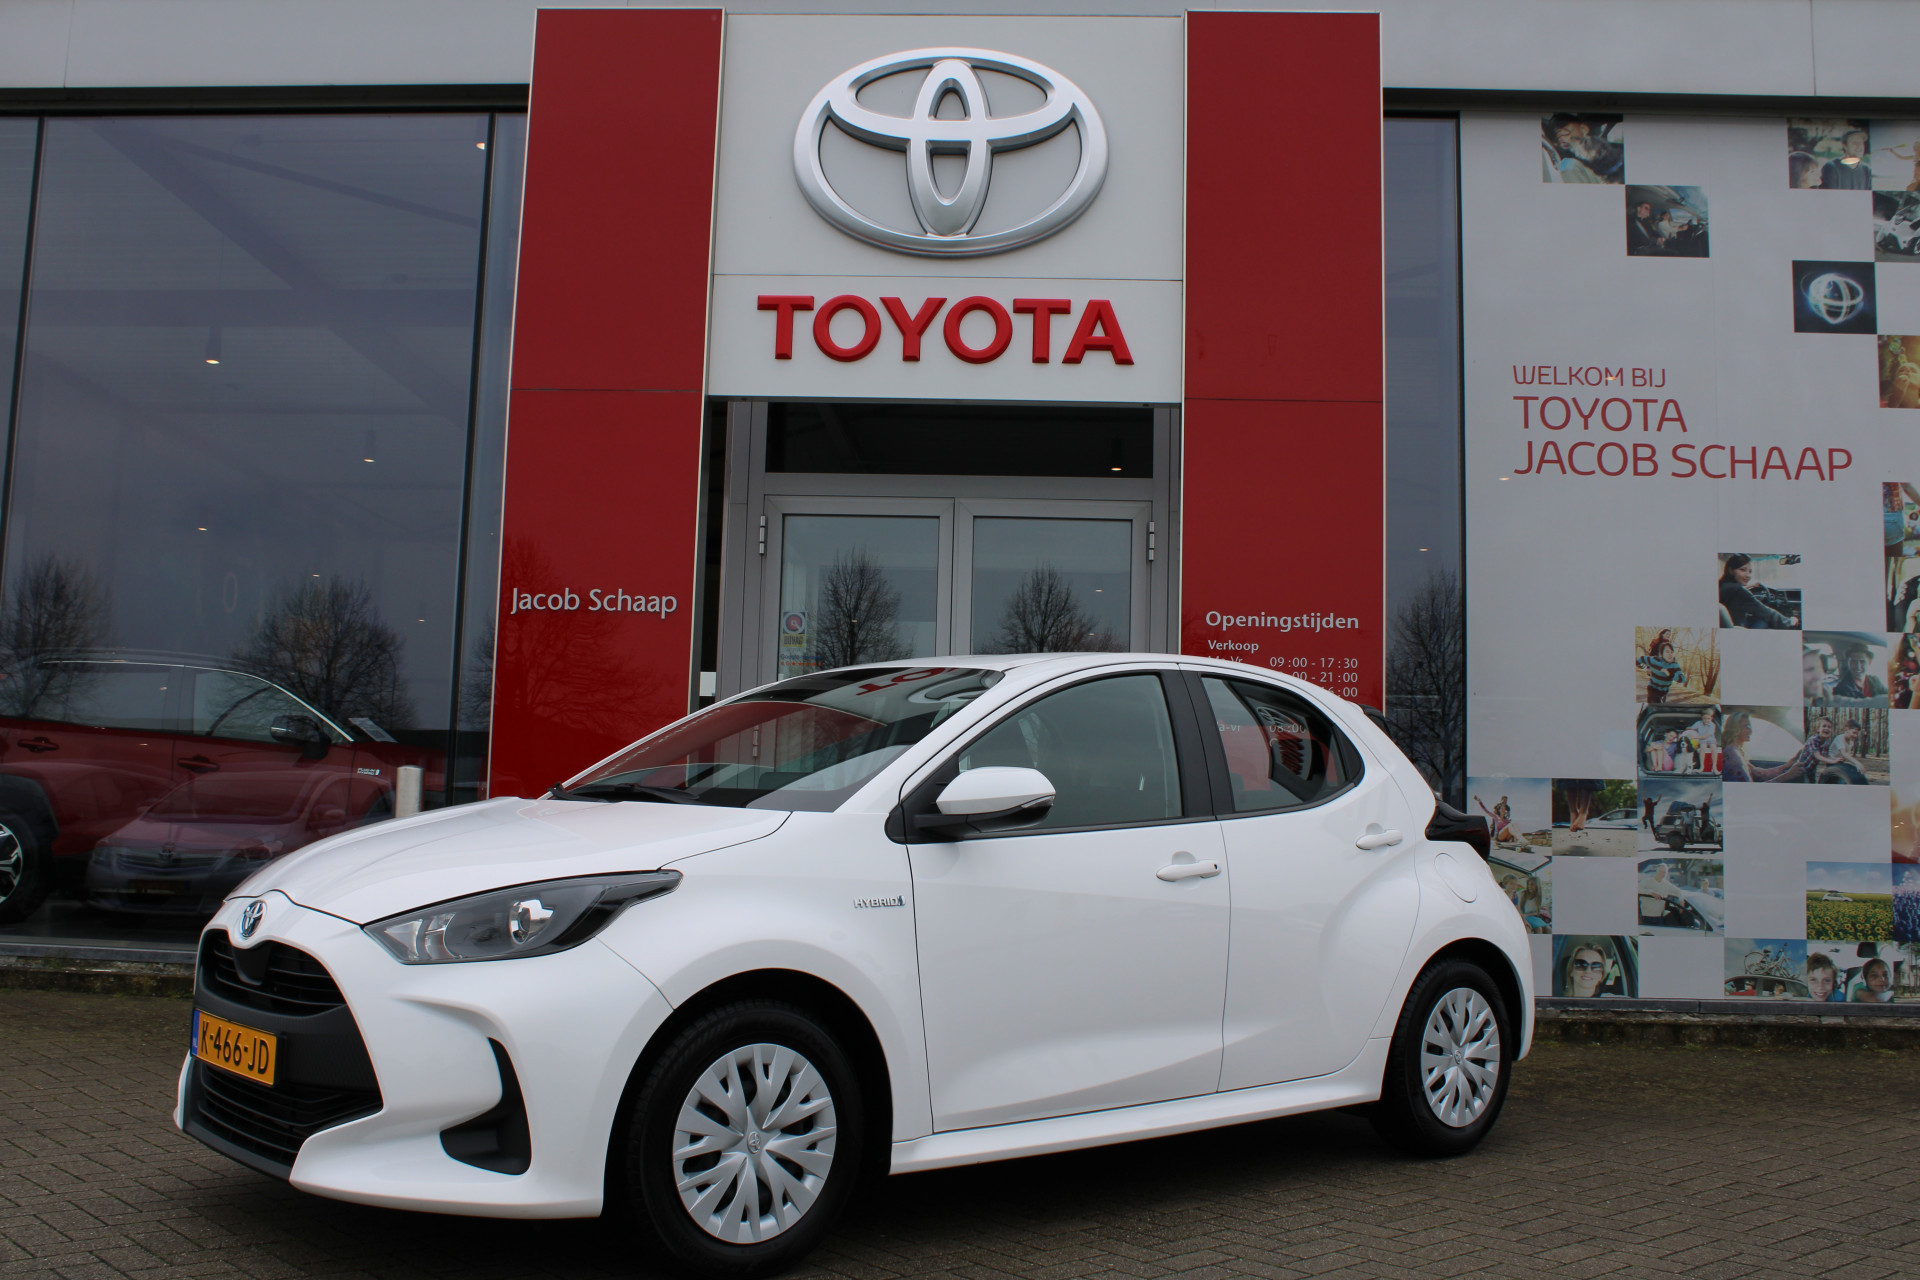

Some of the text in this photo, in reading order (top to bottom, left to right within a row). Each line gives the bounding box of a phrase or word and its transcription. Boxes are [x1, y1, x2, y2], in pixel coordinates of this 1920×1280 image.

[757, 294, 1135, 365] TOYOTA
[1512, 365, 1666, 388] WELKOM BIJ
[1512, 395, 1688, 433] TOYOTA
[1513, 440, 1853, 481] JACOB SCHAAP
[510, 587, 678, 619] Jacob Schaap
[1205, 611, 1359, 633] Openingstijden
[1207, 639, 1259, 652] Verkoop
[854, 897, 899, 908] HYBRID
[202, 1020, 269, 1074] K-466-JD
